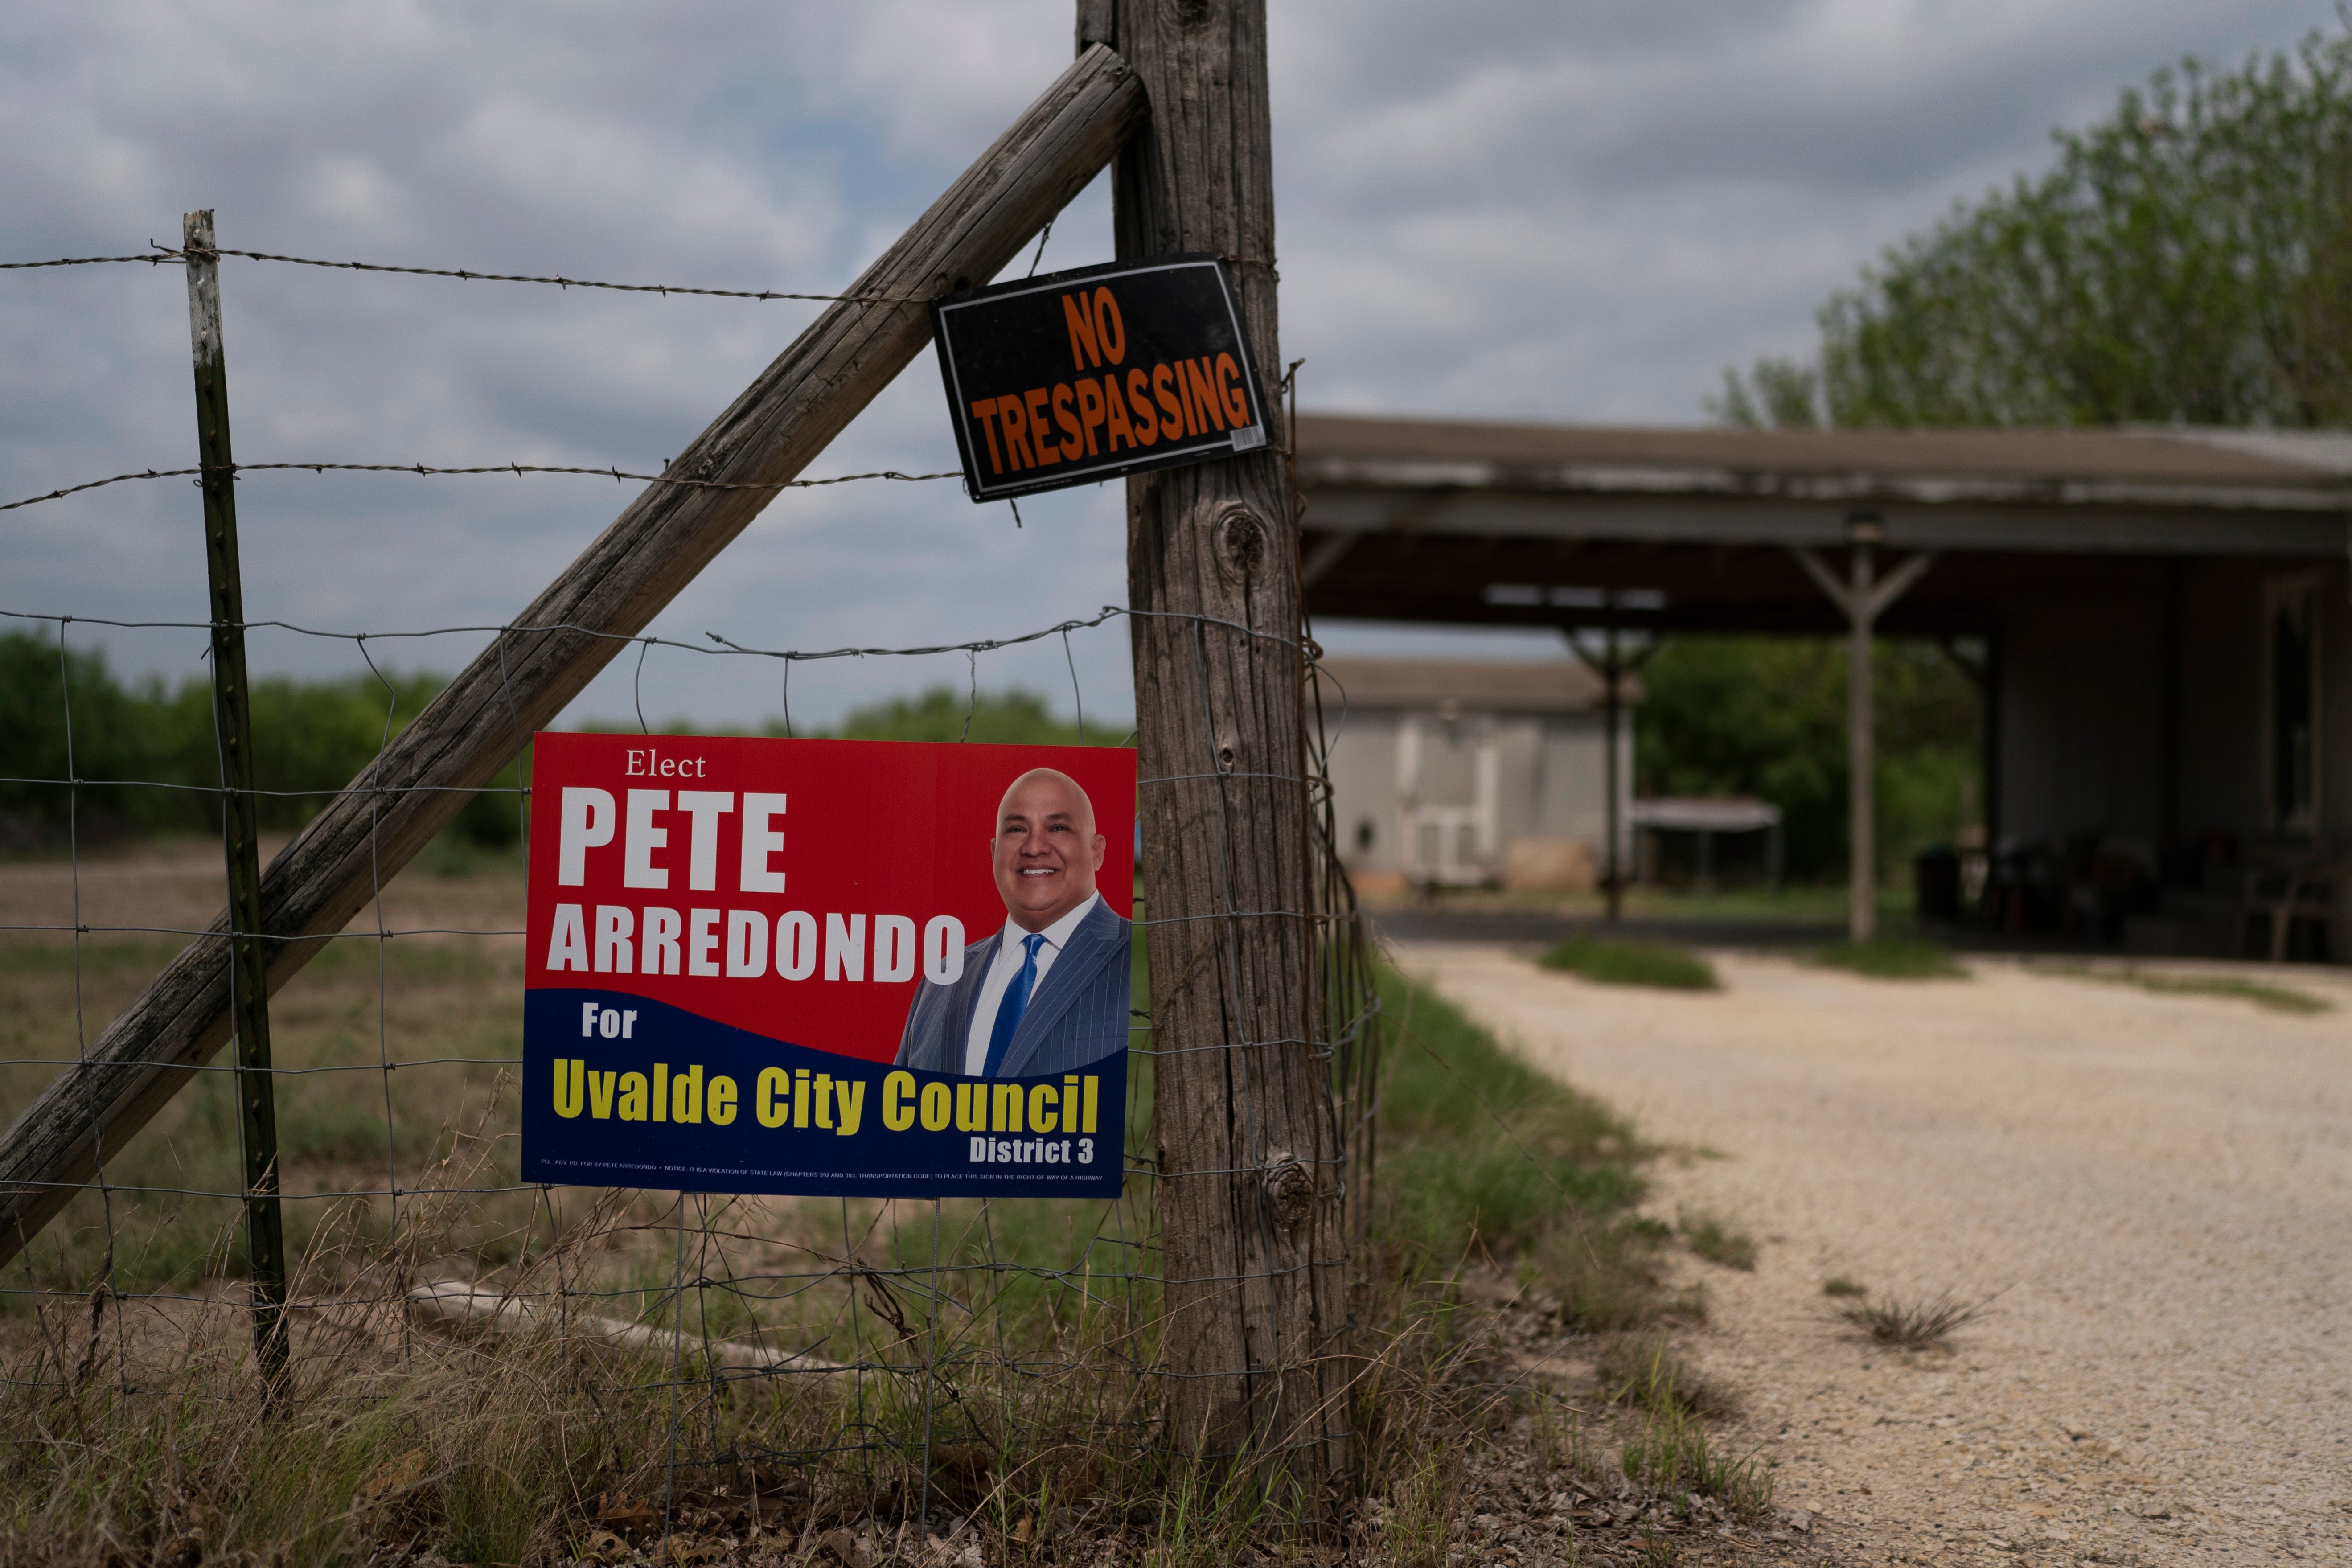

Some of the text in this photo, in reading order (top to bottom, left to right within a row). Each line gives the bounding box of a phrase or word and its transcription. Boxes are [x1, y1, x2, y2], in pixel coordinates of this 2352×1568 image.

[1062, 286, 1125, 371] NO
[972, 352, 1250, 475] TRESPASSING
[625, 749, 706, 778] Elect
[558, 787, 787, 894] PETE
[546, 903, 965, 985] ARREDONDO
[582, 1002, 638, 1039] For
[553, 1058, 1099, 1136] Uvalde City Council
[969, 1137, 1094, 1164] District 3
